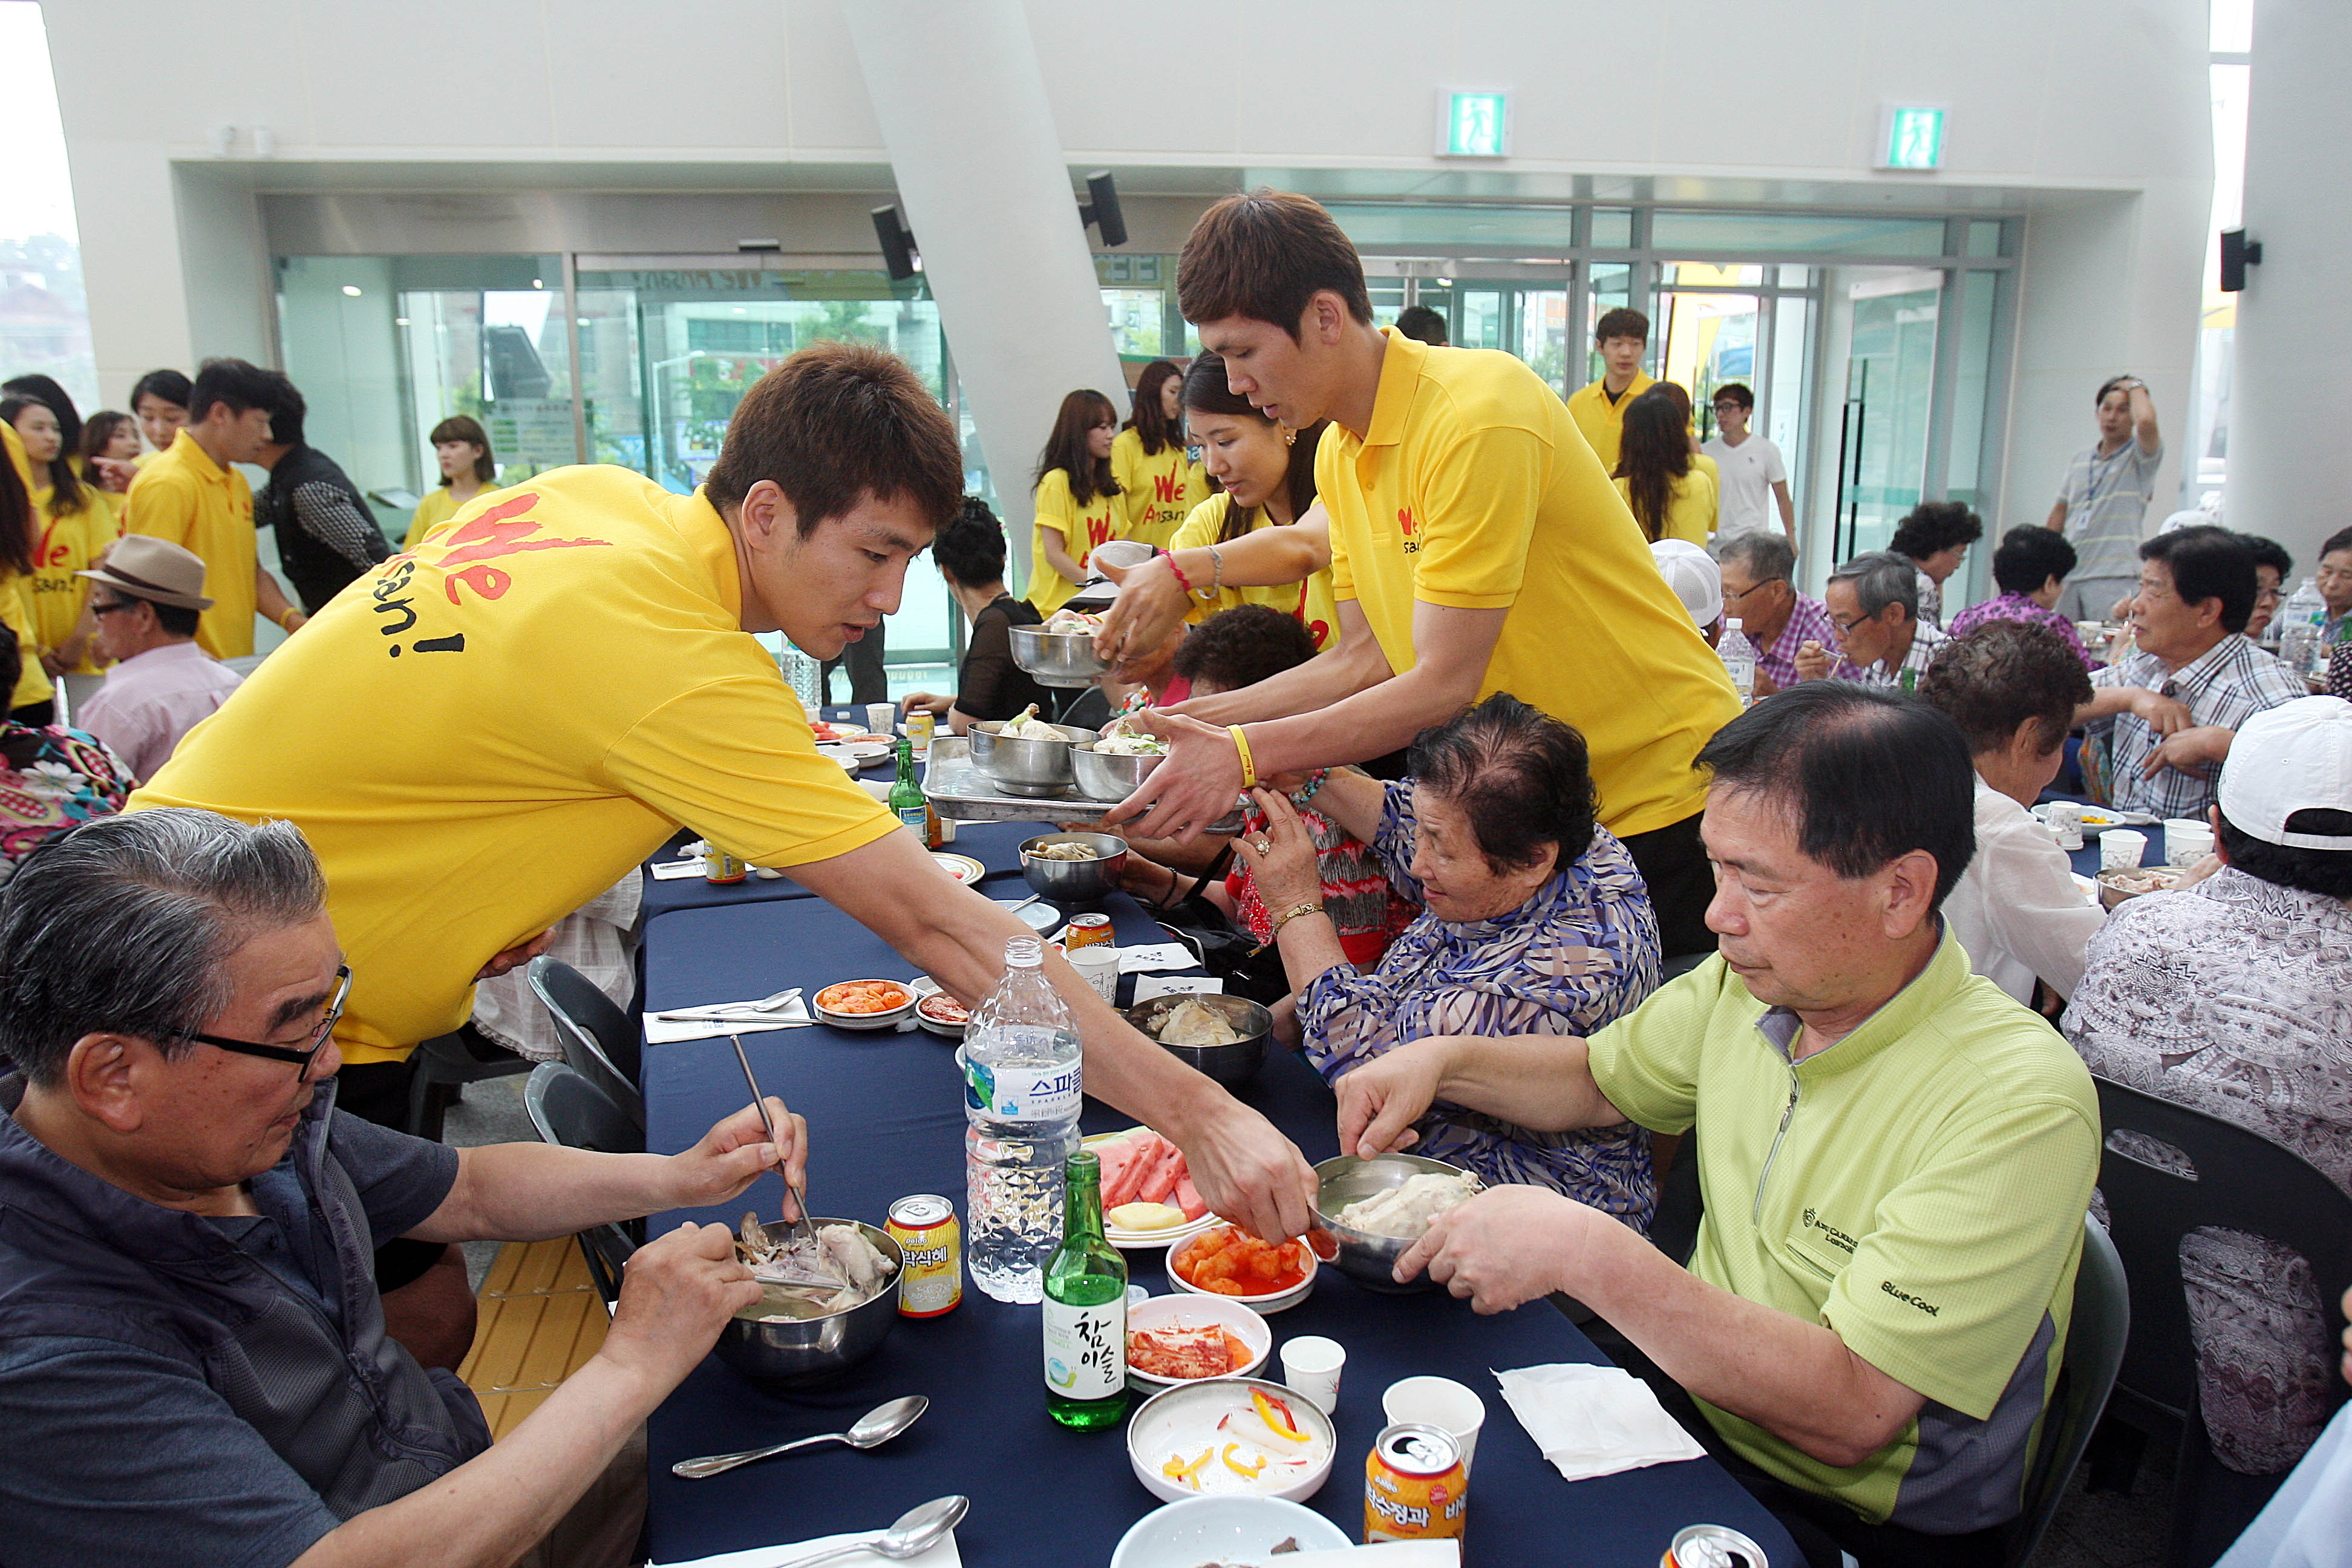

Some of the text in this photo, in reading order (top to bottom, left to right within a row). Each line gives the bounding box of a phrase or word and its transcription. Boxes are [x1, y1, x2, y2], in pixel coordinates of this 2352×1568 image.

[1154, 459, 1186, 503] We
[434, 492, 614, 606] We
[1030, 1066, 1081, 1096] 스파클
